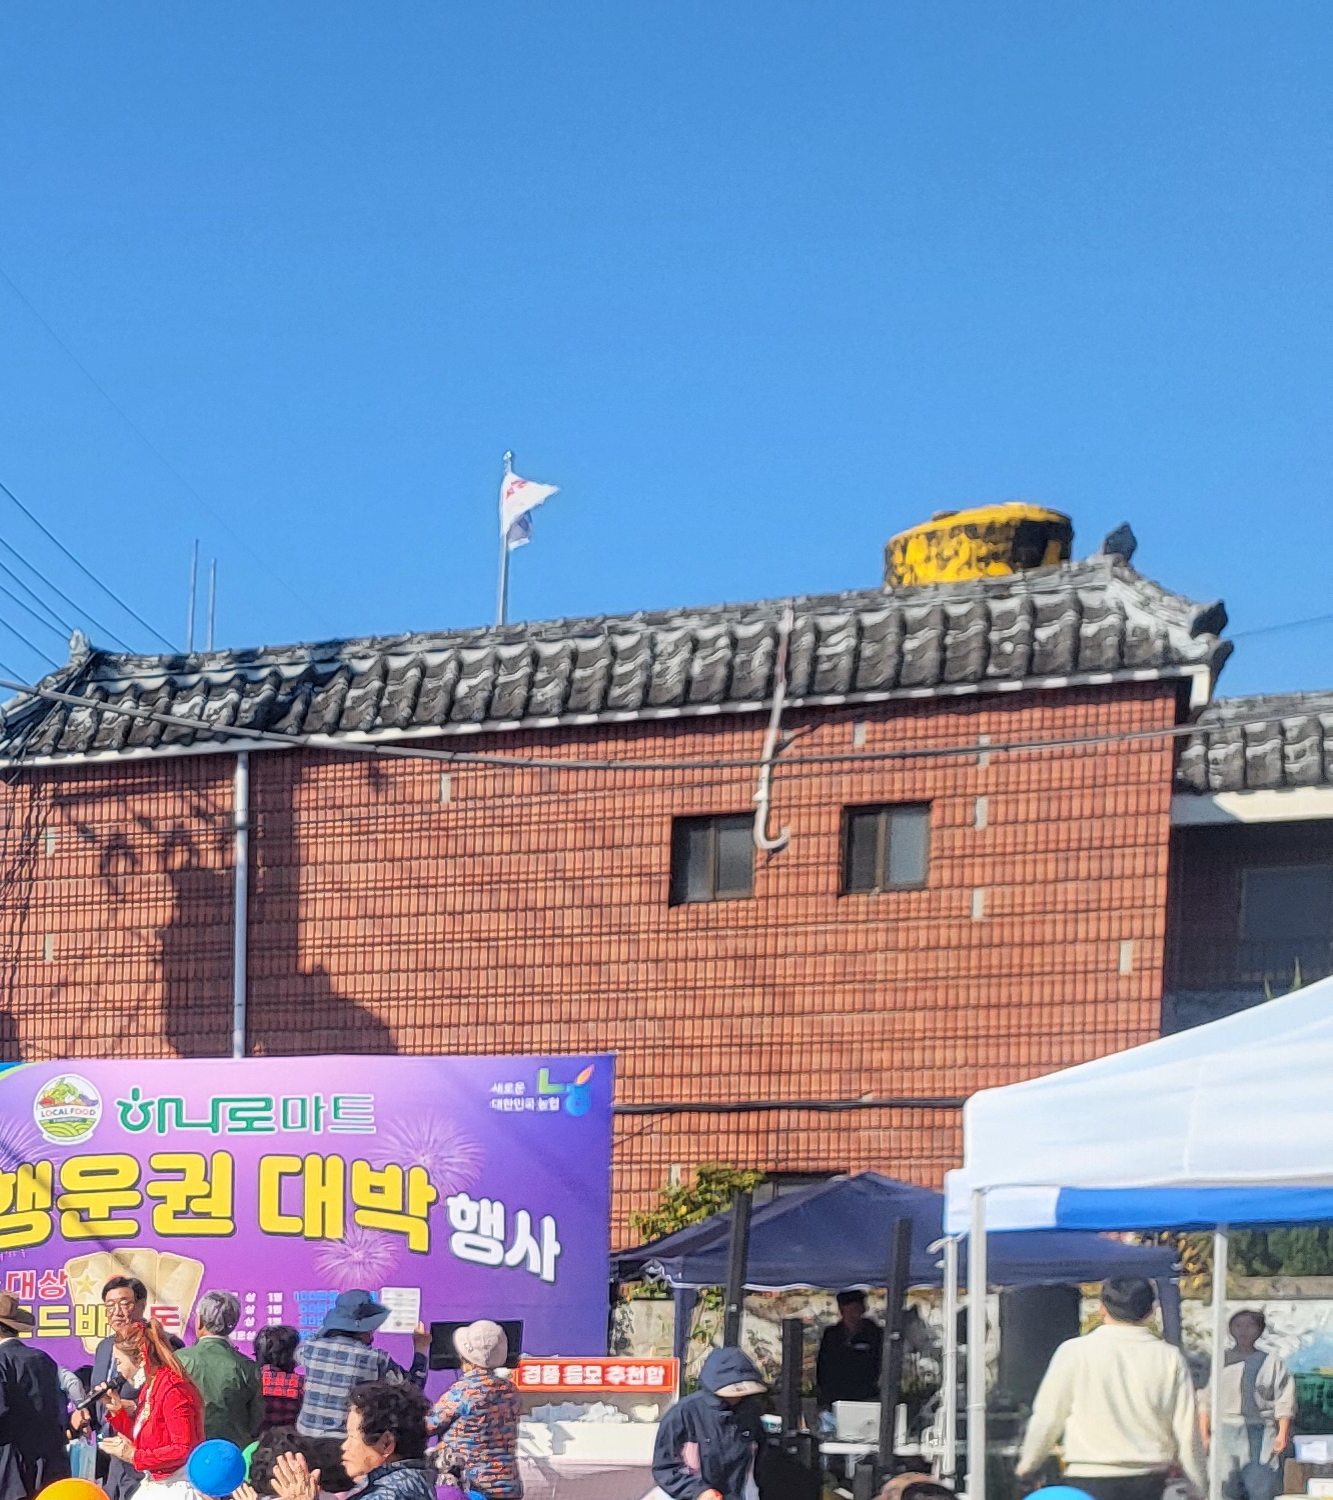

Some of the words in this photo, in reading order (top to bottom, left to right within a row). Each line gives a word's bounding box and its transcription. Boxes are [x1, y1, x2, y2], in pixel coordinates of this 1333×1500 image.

[40, 1107, 69, 1118] LOCAL
[70, 1107, 96, 1117] FOOD
[116, 1087, 376, 1134] 하나로마트
[259, 1153, 437, 1254] 대박
[446, 1192, 561, 1282] 행사
[5, 1269, 68, 1300] 대상
